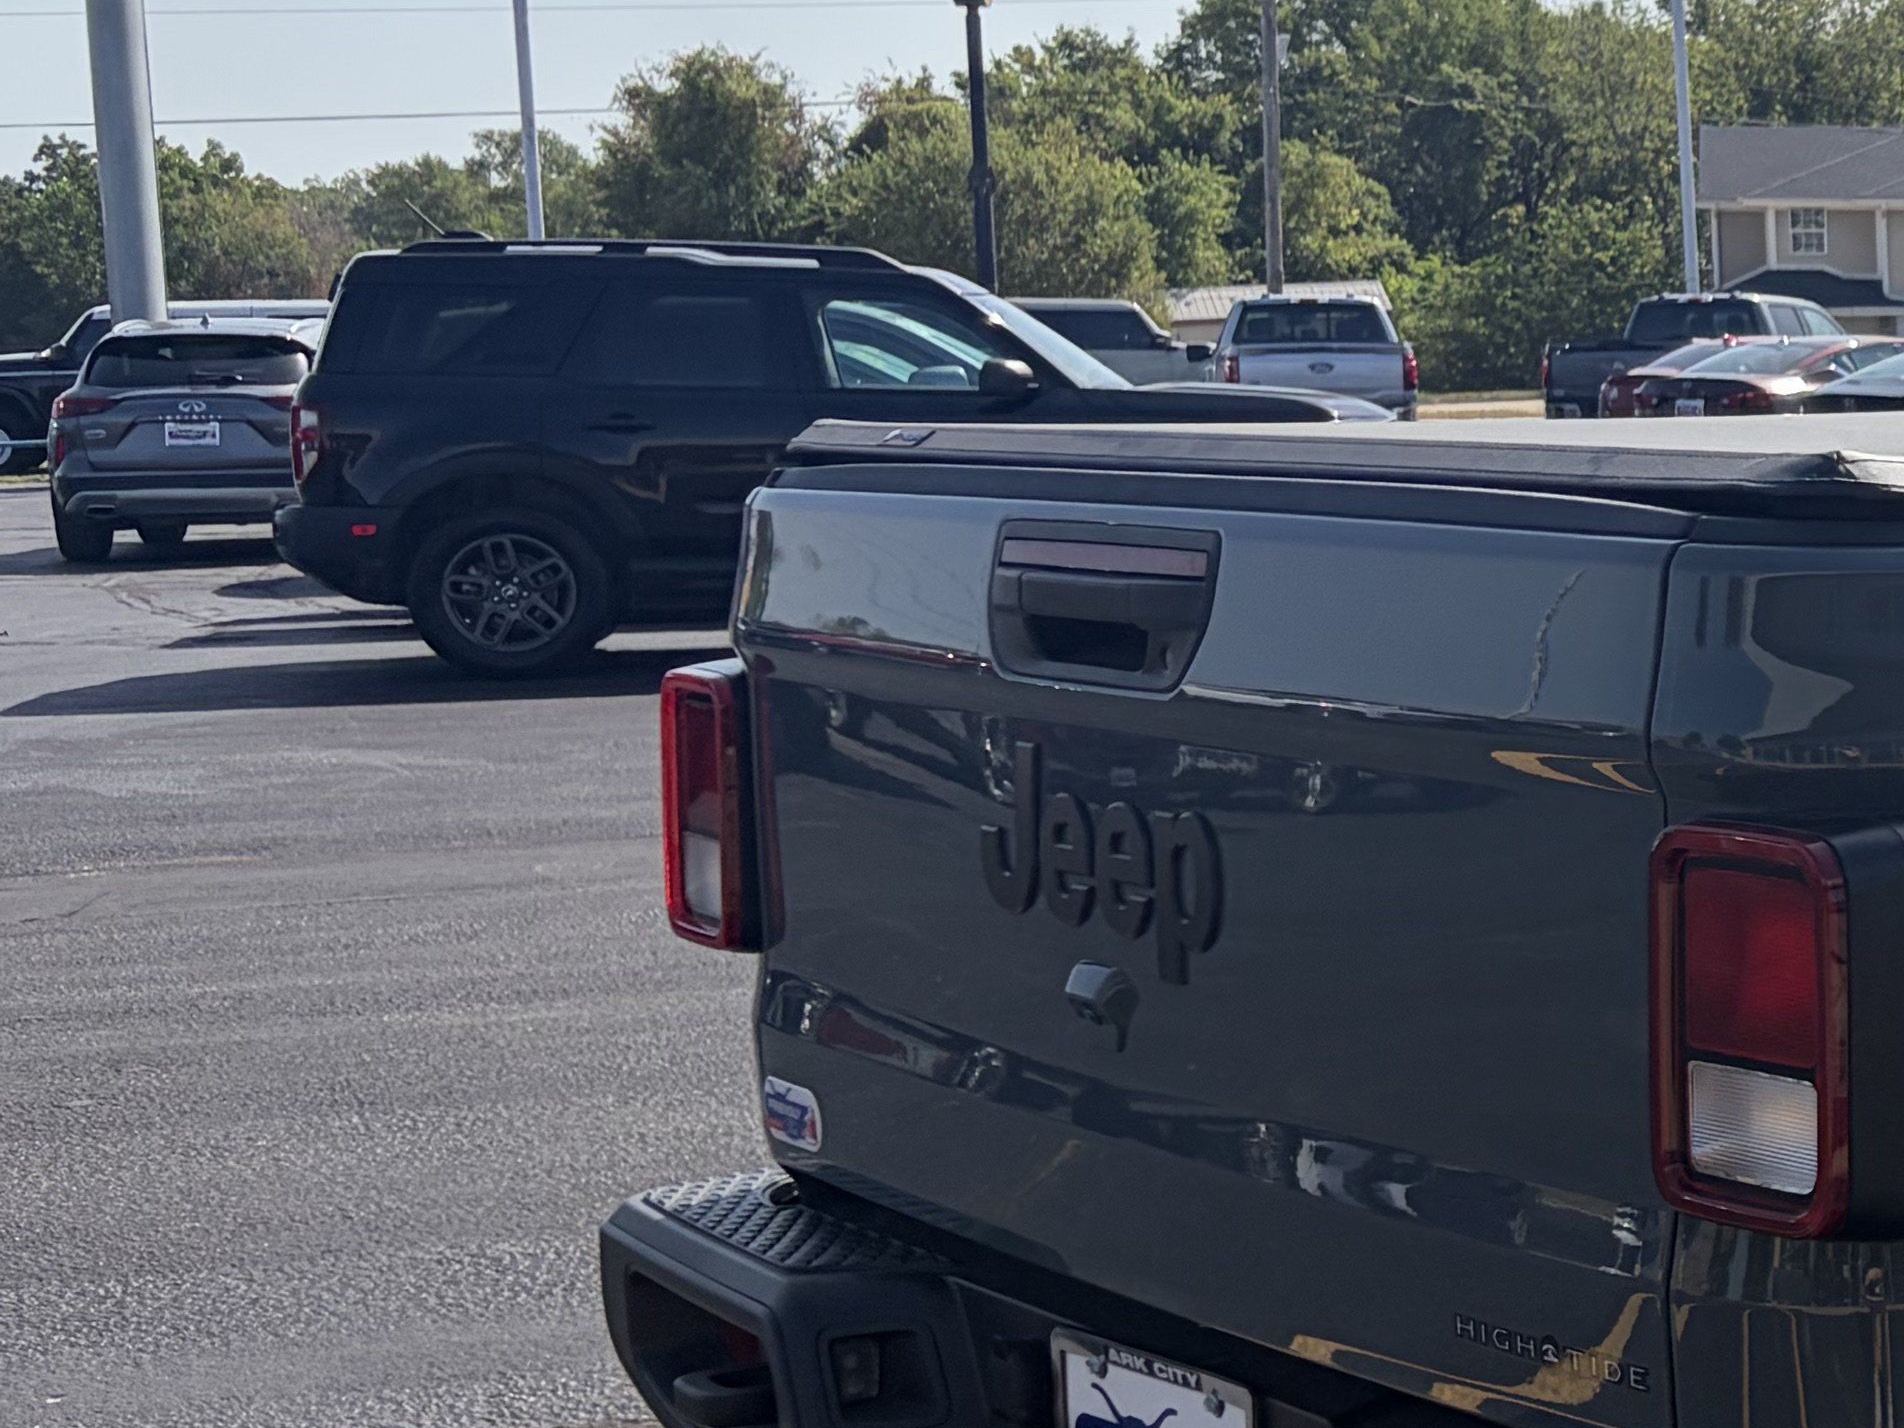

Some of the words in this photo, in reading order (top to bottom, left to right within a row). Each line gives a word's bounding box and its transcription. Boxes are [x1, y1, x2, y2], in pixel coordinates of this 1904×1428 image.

[978, 740, 1224, 986] Jeep
[1107, 1347, 1150, 1373] ARK
[1153, 1361, 1201, 1389] CITY
[1455, 1314, 1536, 1358] HIGH
[1564, 1348, 1649, 1390] TIDE
